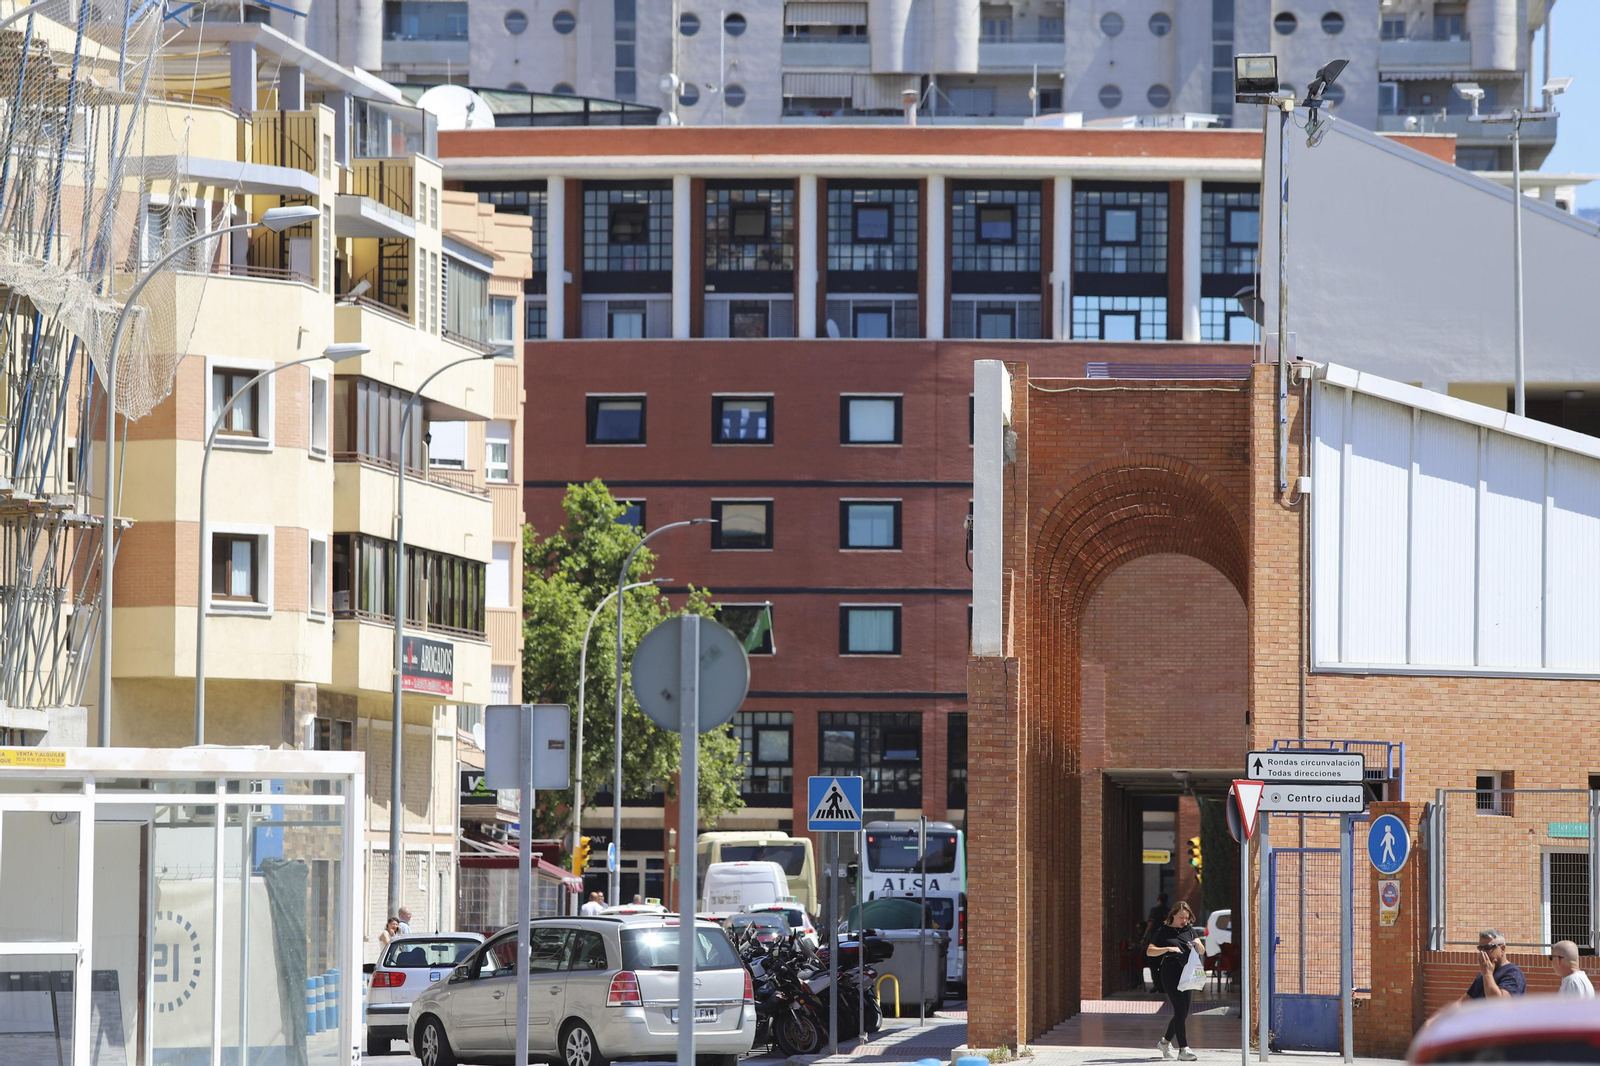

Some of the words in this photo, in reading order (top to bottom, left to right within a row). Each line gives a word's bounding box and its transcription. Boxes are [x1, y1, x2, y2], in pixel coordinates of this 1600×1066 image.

[420, 644, 452, 676] ABOGADOS
[1267, 758, 1298, 766] Rondas
[1300, 759, 1361, 767] circunvalación
[1267, 769, 1292, 777] Todas
[1294, 769, 1342, 778] direcciones
[1287, 793, 1322, 803] Centro
[1325, 794, 1361, 803] ciudad
